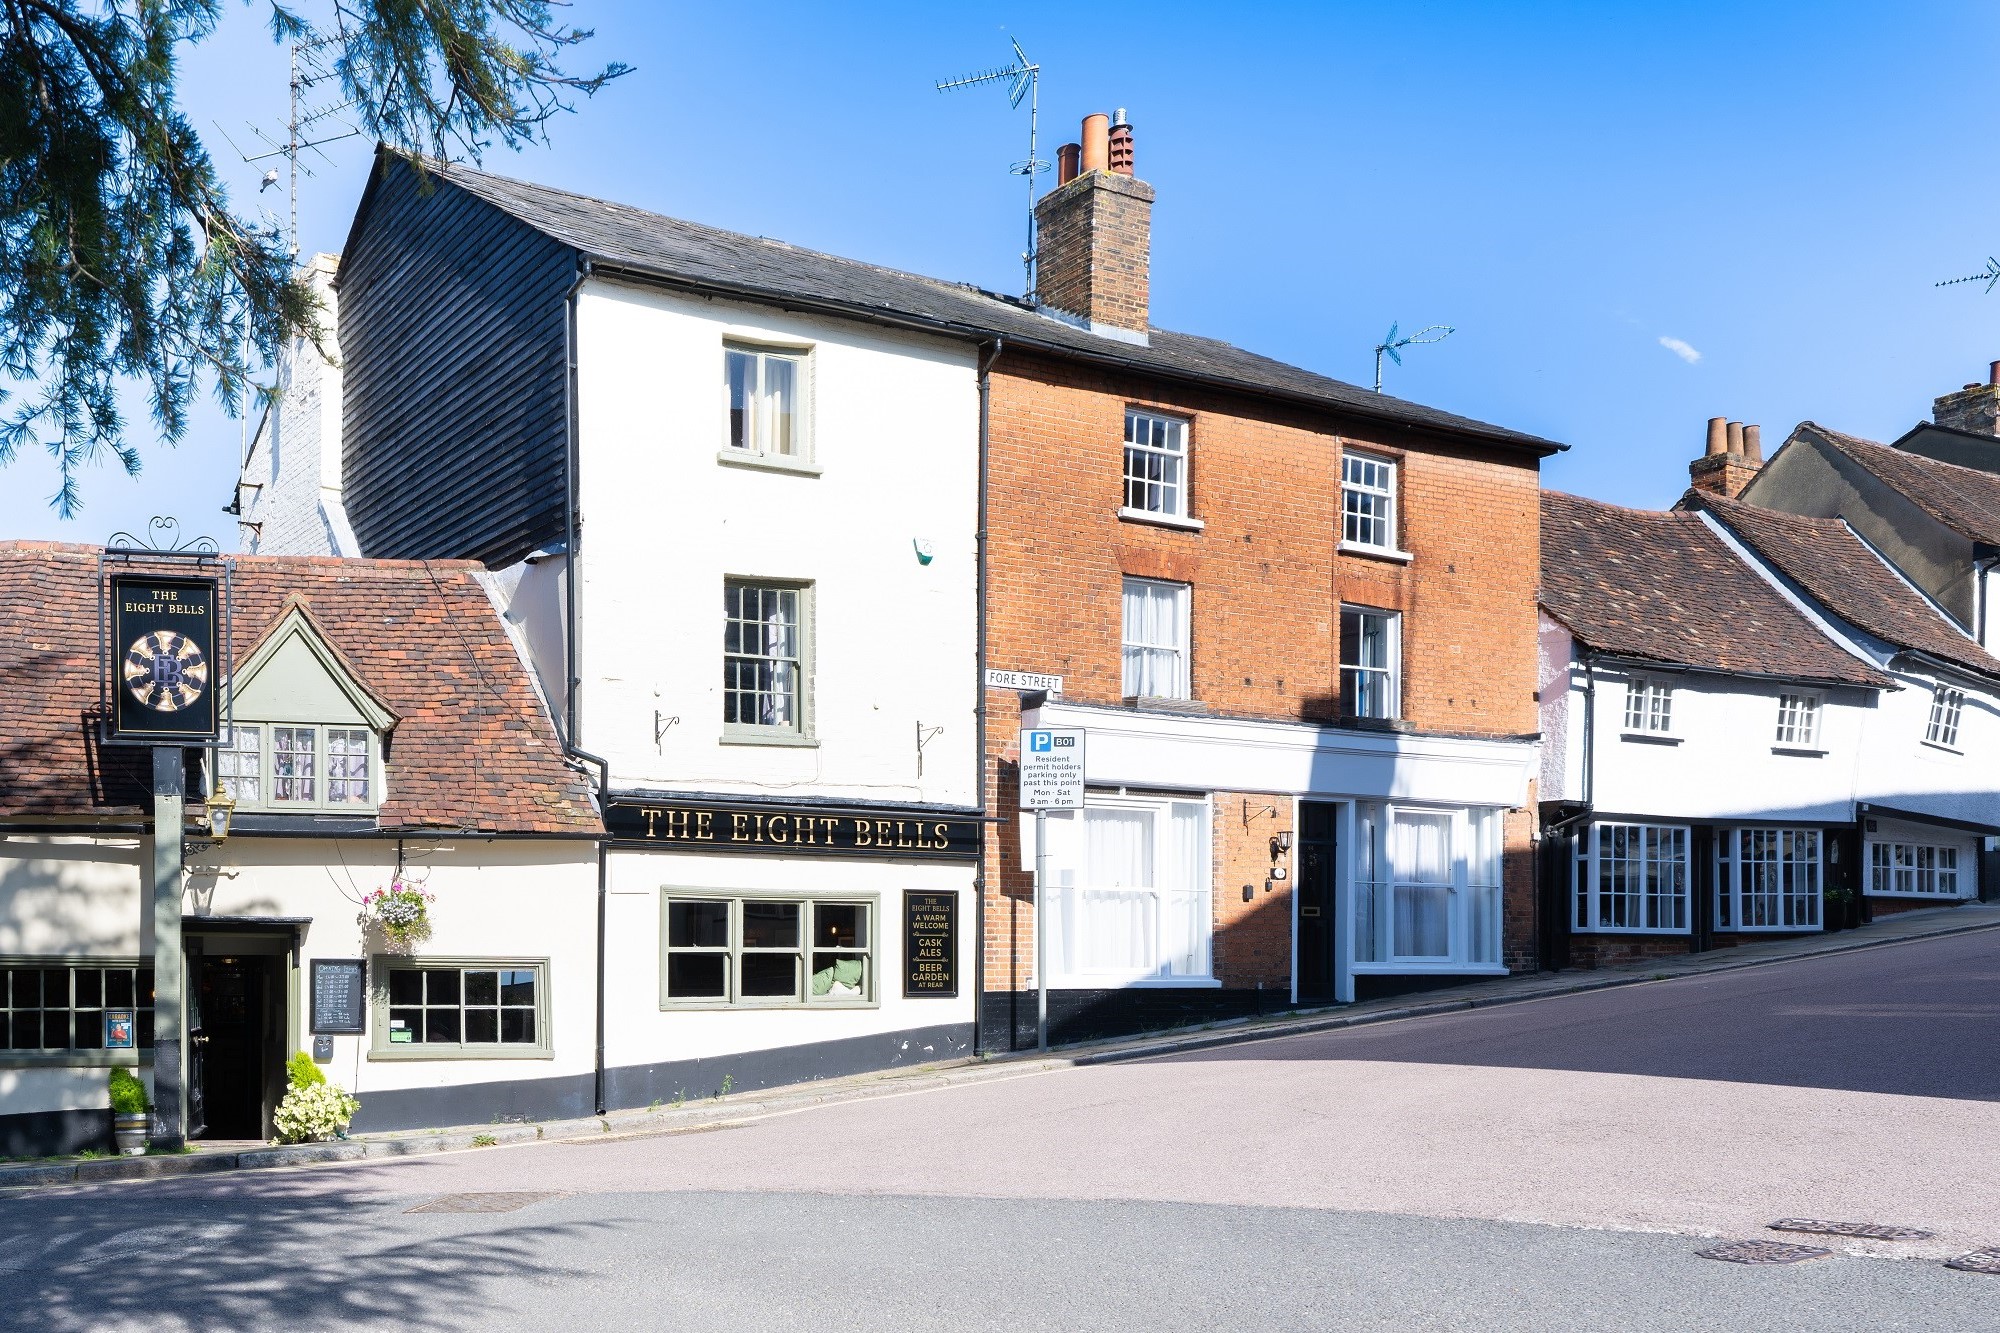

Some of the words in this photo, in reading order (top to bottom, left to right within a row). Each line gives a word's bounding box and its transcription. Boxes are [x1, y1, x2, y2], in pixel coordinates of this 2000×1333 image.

[152, 590, 177, 600] THE
[126, 602, 163, 612] EIGHT
[169, 604, 204, 614] BELLS
[990, 672, 1016, 684] FORE
[1021, 675, 1059, 688] STREET
[1036, 734, 1048, 750] P
[642, 809, 713, 839] THE
[732, 813, 839, 845] EIGHT
[854, 820, 949, 849] BELLS
